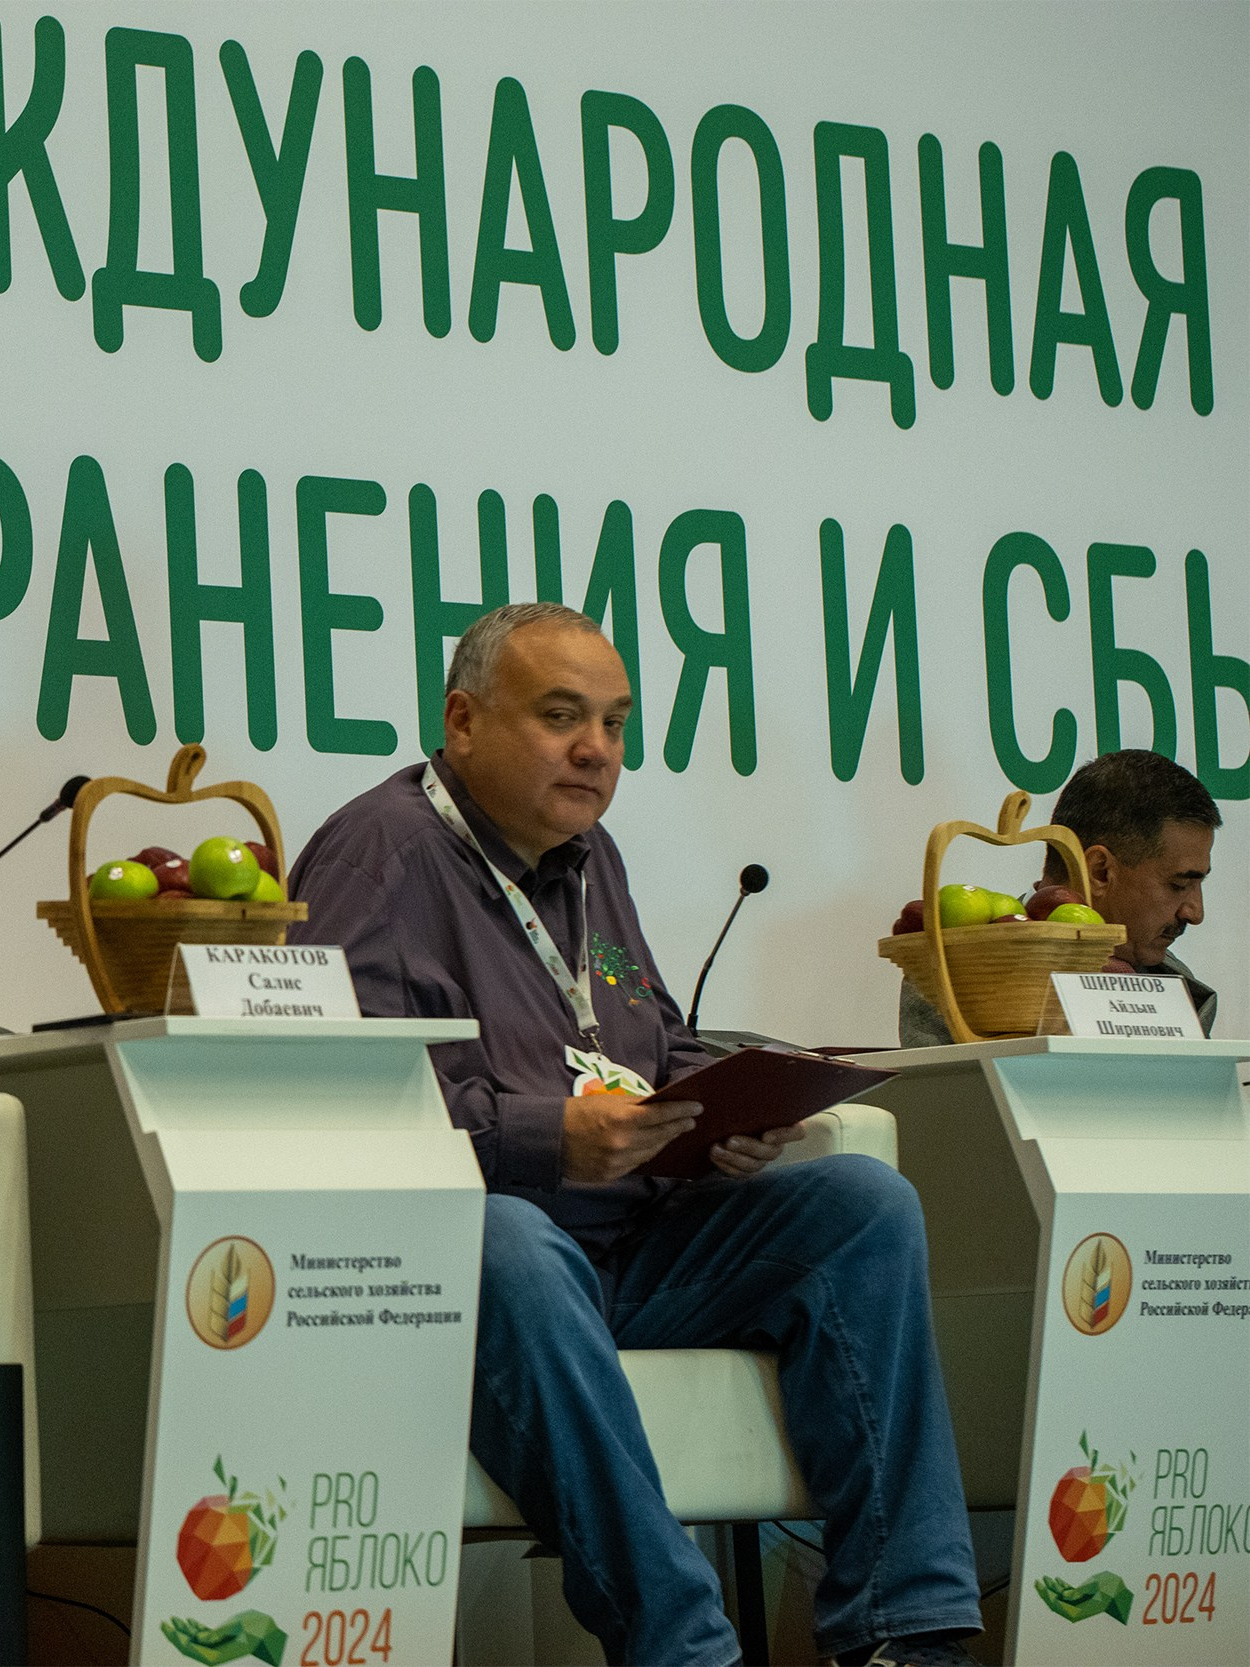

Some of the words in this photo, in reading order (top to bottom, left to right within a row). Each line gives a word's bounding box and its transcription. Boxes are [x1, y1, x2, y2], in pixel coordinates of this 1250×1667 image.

[819, 517, 925, 786] И
[206, 947, 328, 967] КАРАКОТОВ
[248, 972, 303, 991] Салис
[1079, 974, 1165, 993] ШИРИНОВ
[241, 997, 324, 1017] Добаевич
[1109, 999, 1157, 1014] Айдын
[1096, 1020, 1184, 1037] Ширинович
[289, 1253, 402, 1273] Министерство
[1143, 1250, 1232, 1268] Министерство
[287, 1283, 364, 1299] сельского
[367, 1281, 443, 1297] хозяйства
[1141, 1279, 1202, 1291] сельского
[1204, 1276, 1250, 1290] хозяйст
[286, 1309, 374, 1328] Российской
[378, 1308, 462, 1328] Федерации
[1140, 1301, 1209, 1316] Российской
[1212, 1301, 1250, 1319] Федер
[1153, 1447, 1209, 1500] PRO
[309, 1471, 379, 1530] PRO
[305, 1529, 448, 1593] ЯБЛОКО
[1142, 1571, 1216, 1625] 2024
[300, 1607, 392, 1667] 2024
